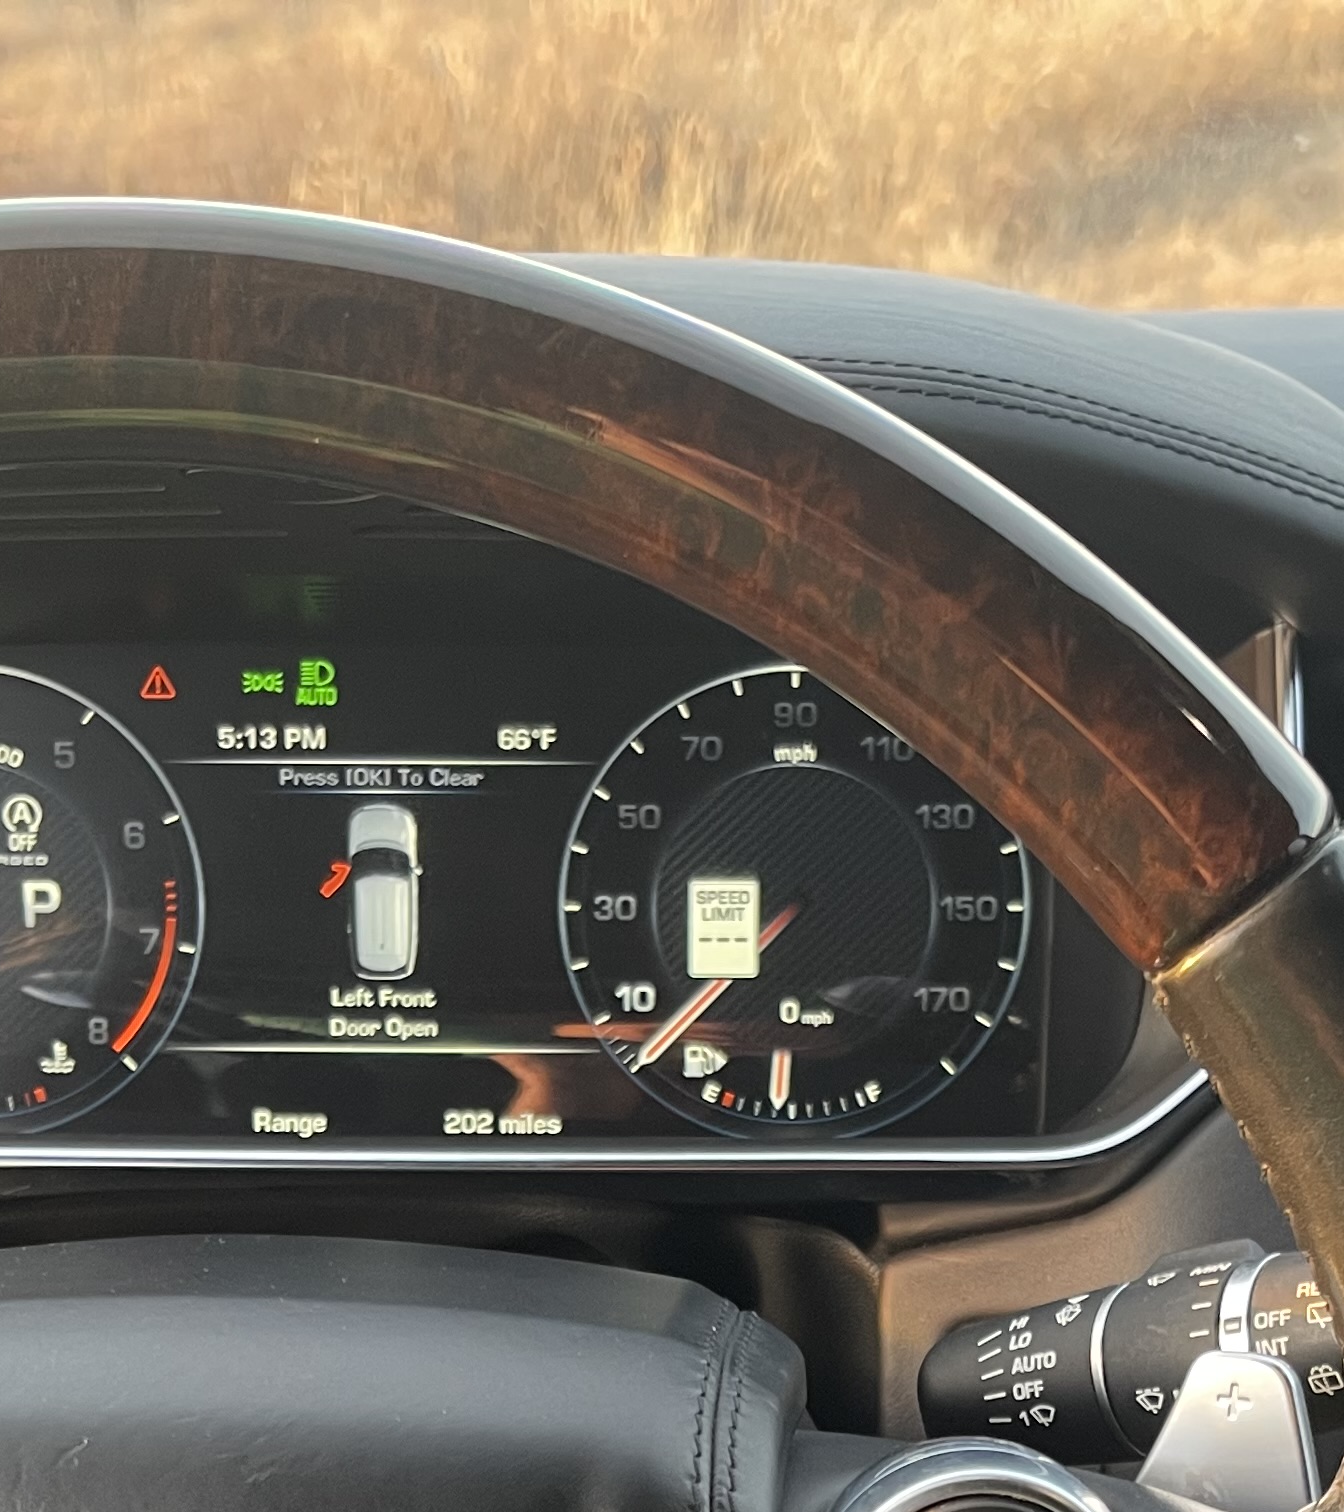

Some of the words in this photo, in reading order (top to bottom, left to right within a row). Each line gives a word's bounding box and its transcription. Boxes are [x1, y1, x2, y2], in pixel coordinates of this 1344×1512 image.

[296, 687, 338, 706] AUTO
[773, 702, 817, 728] 90
[217, 724, 277, 749] 5:13
[283, 724, 327, 750] PM
[497, 724, 556, 751] 66°F
[681, 736, 723, 761] 70
[861, 736, 915, 762] 110
[55, 742, 75, 768] 5
[773, 741, 818, 763] mph
[279, 768, 339, 786] Press
[398, 768, 424, 786] To
[429, 768, 484, 786] Clear
[618, 804, 661, 830] 50
[915, 804, 975, 830] 130
[8, 834, 37, 851] OFF
[123, 822, 145, 848] 6
[22, 879, 62, 928] P
[593, 896, 636, 922] 30
[696, 890, 750, 905] SPEED
[940, 896, 998, 922] 150
[701, 906, 746, 922] LIMIT
[140, 928, 160, 954] 7
[330, 988, 374, 1008] Left
[378, 988, 437, 1008] Front
[615, 983, 657, 1012] 10
[913, 986, 970, 1012] 170
[778, 997, 800, 1024] 0
[800, 1008, 835, 1026] mph
[88, 1017, 109, 1044] 8
[329, 1017, 379, 1037] Door
[384, 1017, 439, 1041] Open
[702, 1080, 722, 1103] E
[865, 1079, 883, 1103] F
[252, 1108, 328, 1138] Range
[443, 1110, 494, 1135] 202
[498, 1110, 562, 1136] miles
[1254, 1309, 1291, 1330] OFF
[1009, 1331, 1032, 1351] LO
[1011, 1351, 1056, 1375] AUTO
[1013, 1380, 1044, 1401] OFF
